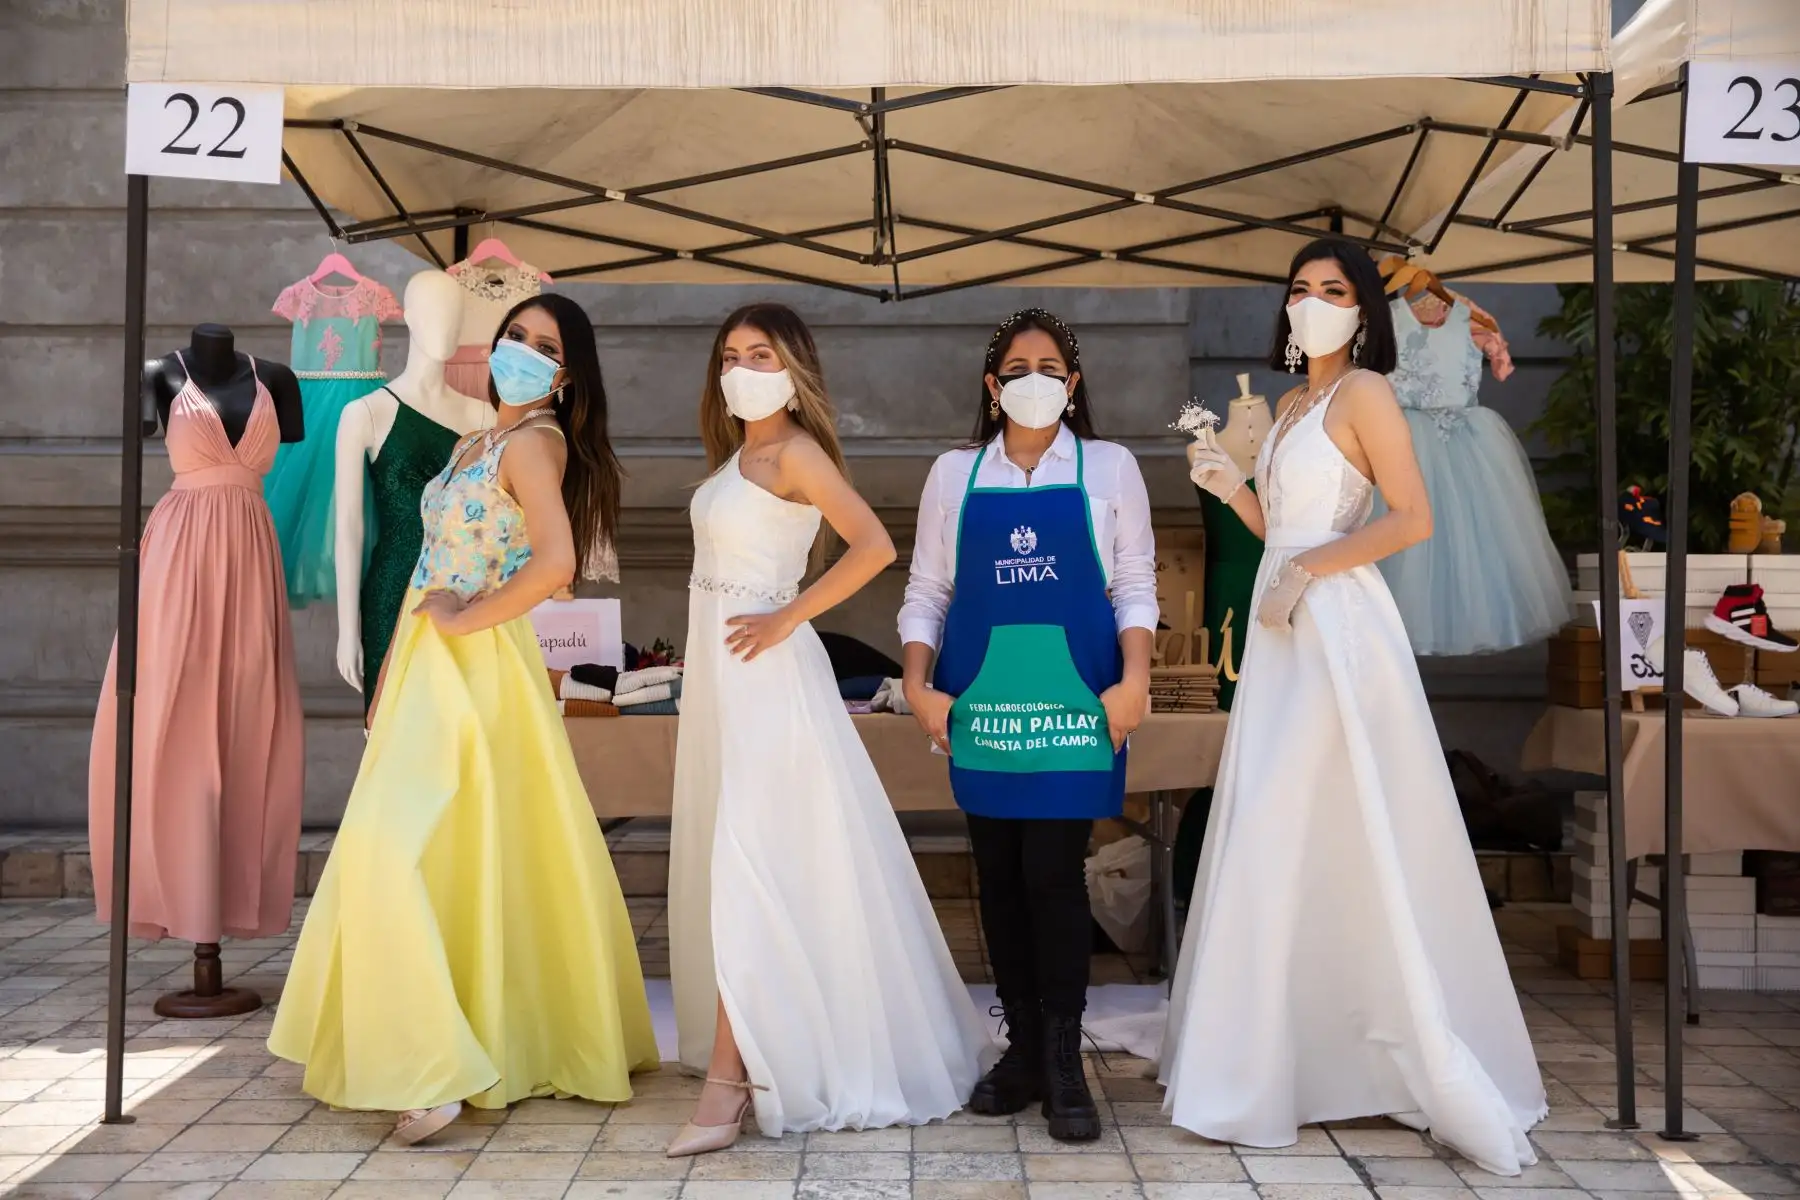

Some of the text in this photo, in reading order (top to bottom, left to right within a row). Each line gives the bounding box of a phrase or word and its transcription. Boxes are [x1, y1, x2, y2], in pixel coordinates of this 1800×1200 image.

[1722, 75, 1800, 142] 23
[160, 92, 247, 159] 22
[995, 556, 1044, 566] MUNICIPALIDAD
[996, 565, 1059, 585] LIMA
[536, 631, 587, 653] apadú
[969, 703, 993, 712] FERIA
[970, 713, 1099, 734] ALLIN PALLAY
[1026, 736, 1049, 750] DEL
[1052, 734, 1098, 747] CAMPO
